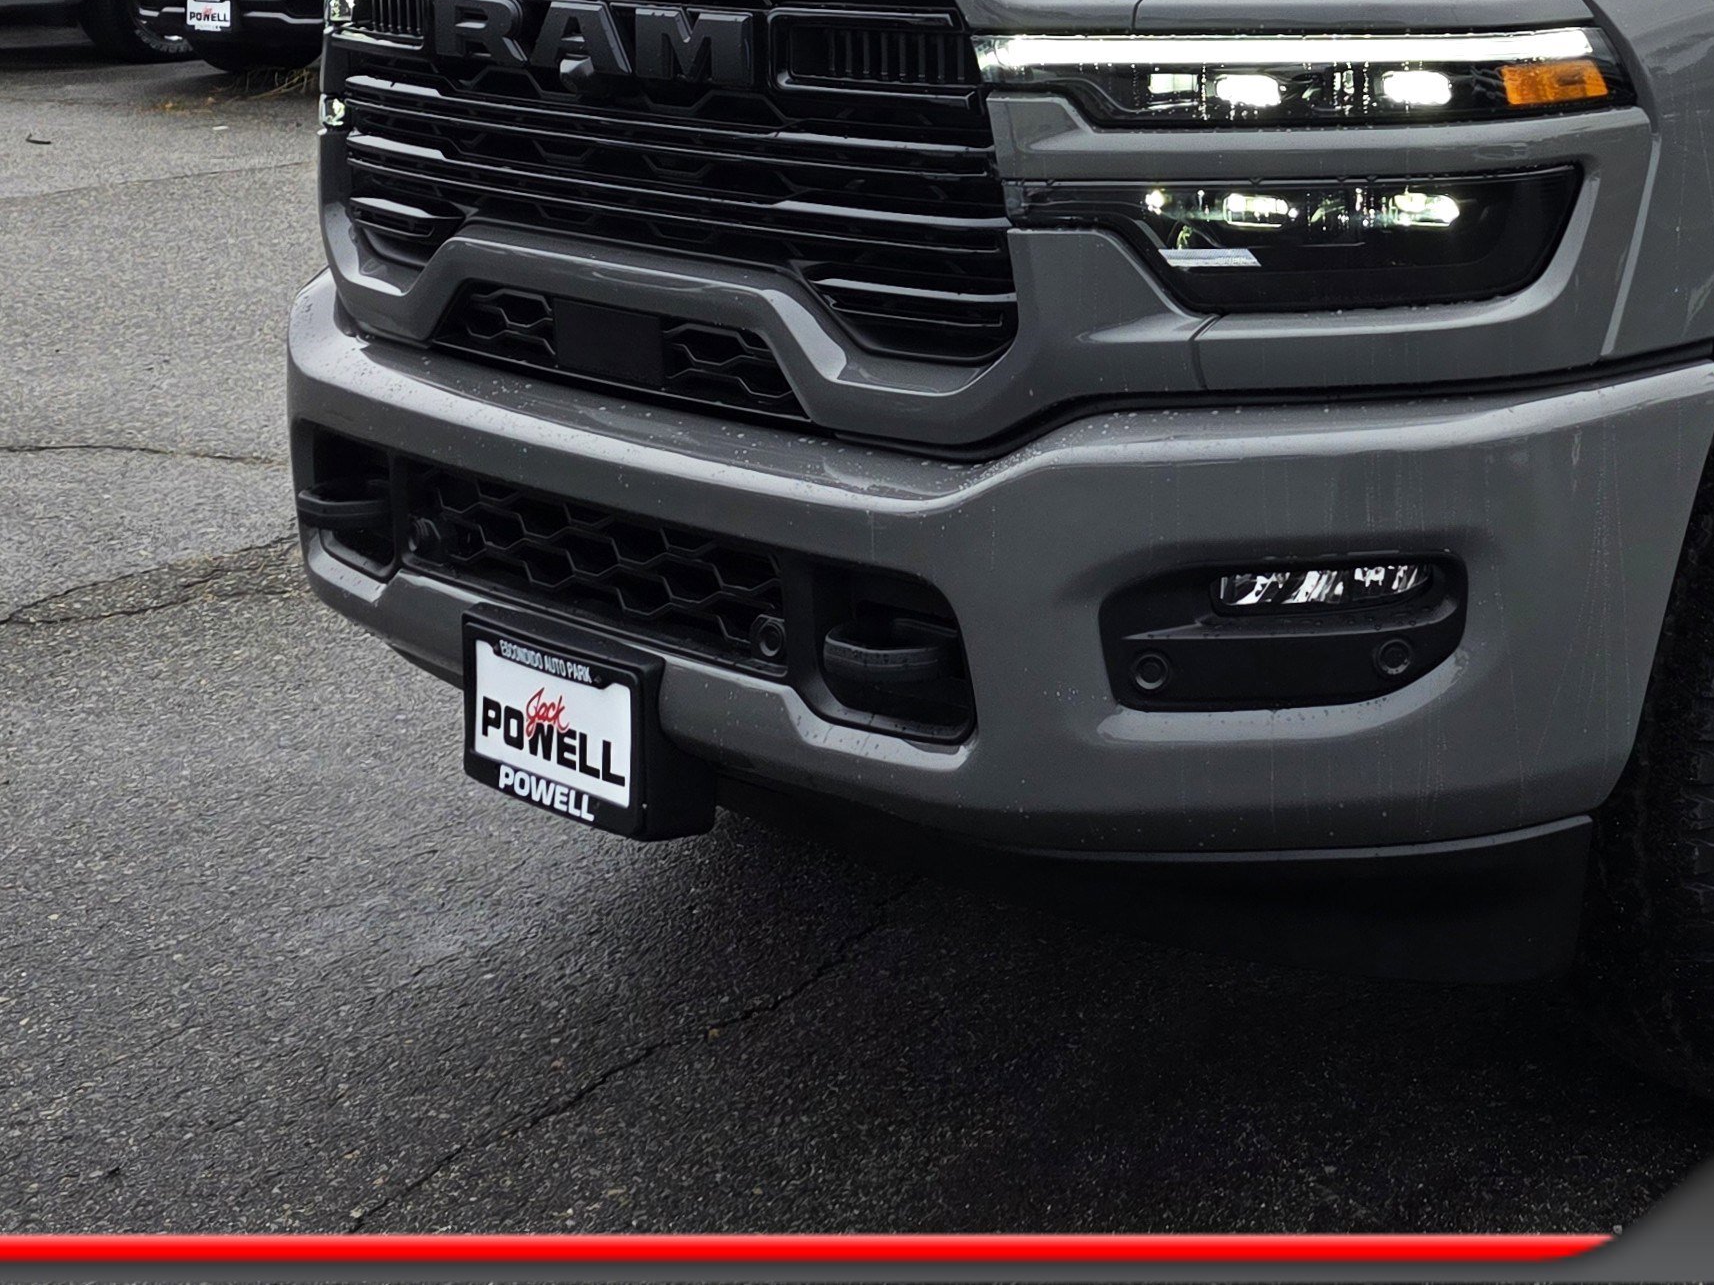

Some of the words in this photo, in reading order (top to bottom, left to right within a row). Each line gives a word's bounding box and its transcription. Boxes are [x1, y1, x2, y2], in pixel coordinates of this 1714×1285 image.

[544, 654, 567, 677] AUTO
[566, 661, 593, 684] PARK
[525, 687, 570, 738] Jack
[481, 695, 626, 787] POWELL
[498, 764, 595, 822] POWELL
